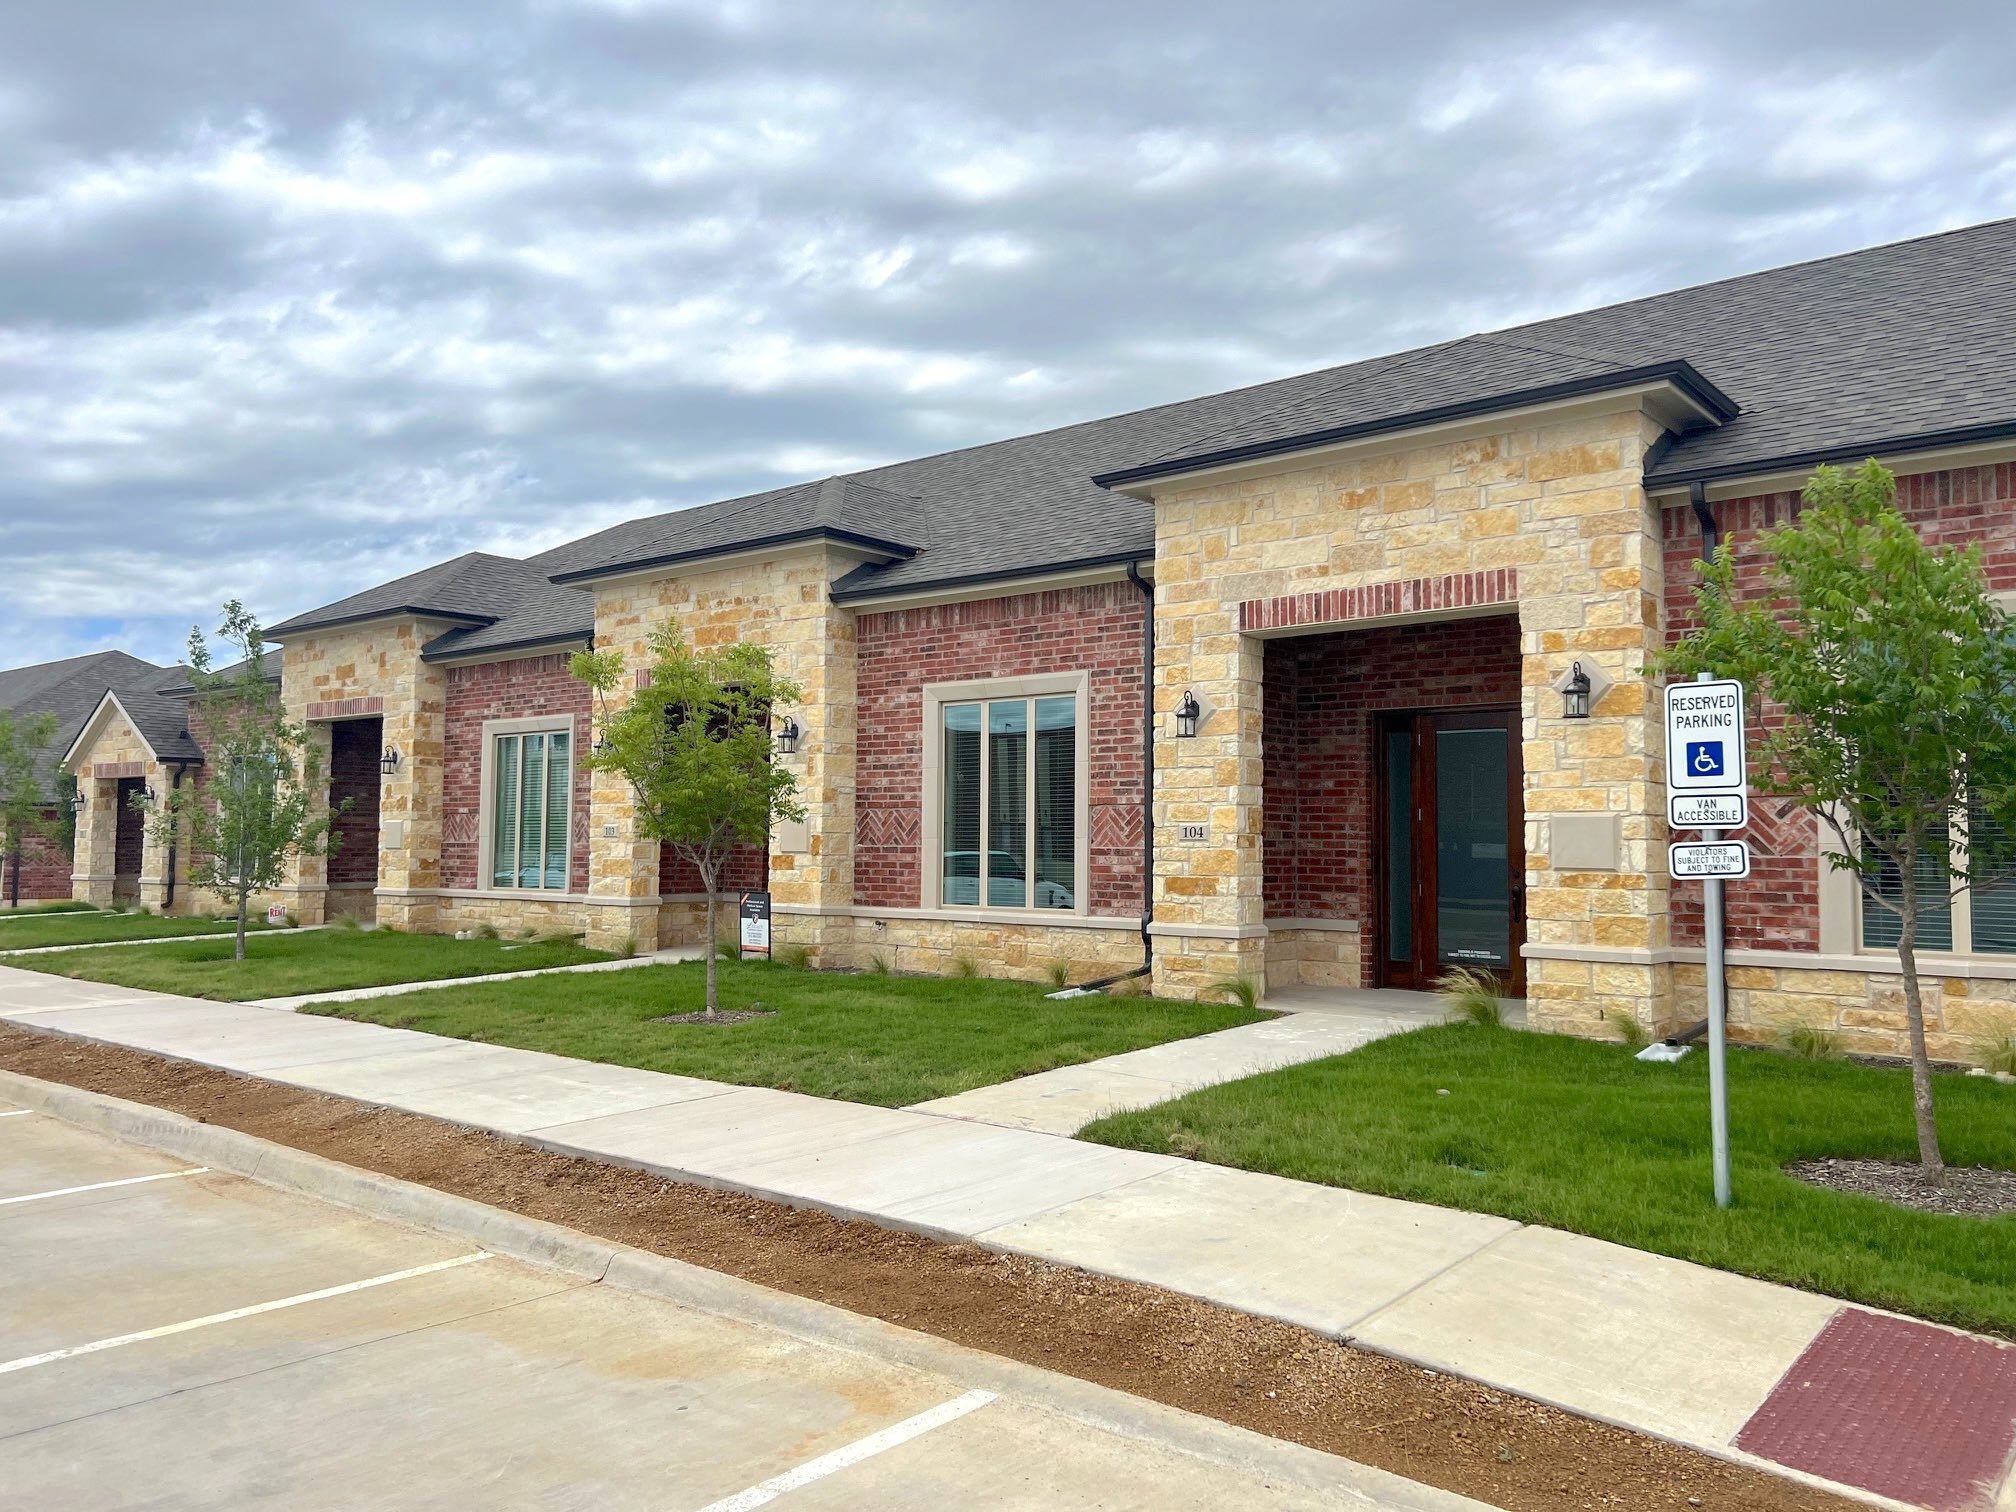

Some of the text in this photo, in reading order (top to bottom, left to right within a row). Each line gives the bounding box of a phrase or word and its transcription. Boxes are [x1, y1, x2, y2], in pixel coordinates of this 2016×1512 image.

[1671, 695, 1736, 711] RESERVED
[1676, 713, 1732, 729] PARKING
[1696, 799, 1717, 809] VAN
[1677, 810, 1738, 821] ACCESSIBLE
[1183, 826, 1204, 838] 104
[1688, 848, 1728, 856] VIOLATORS
[1677, 855, 1740, 865] SUBJECT TO FINE
[1687, 863, 1732, 872] AND TOWING
[270, 906, 286, 917] RENT
